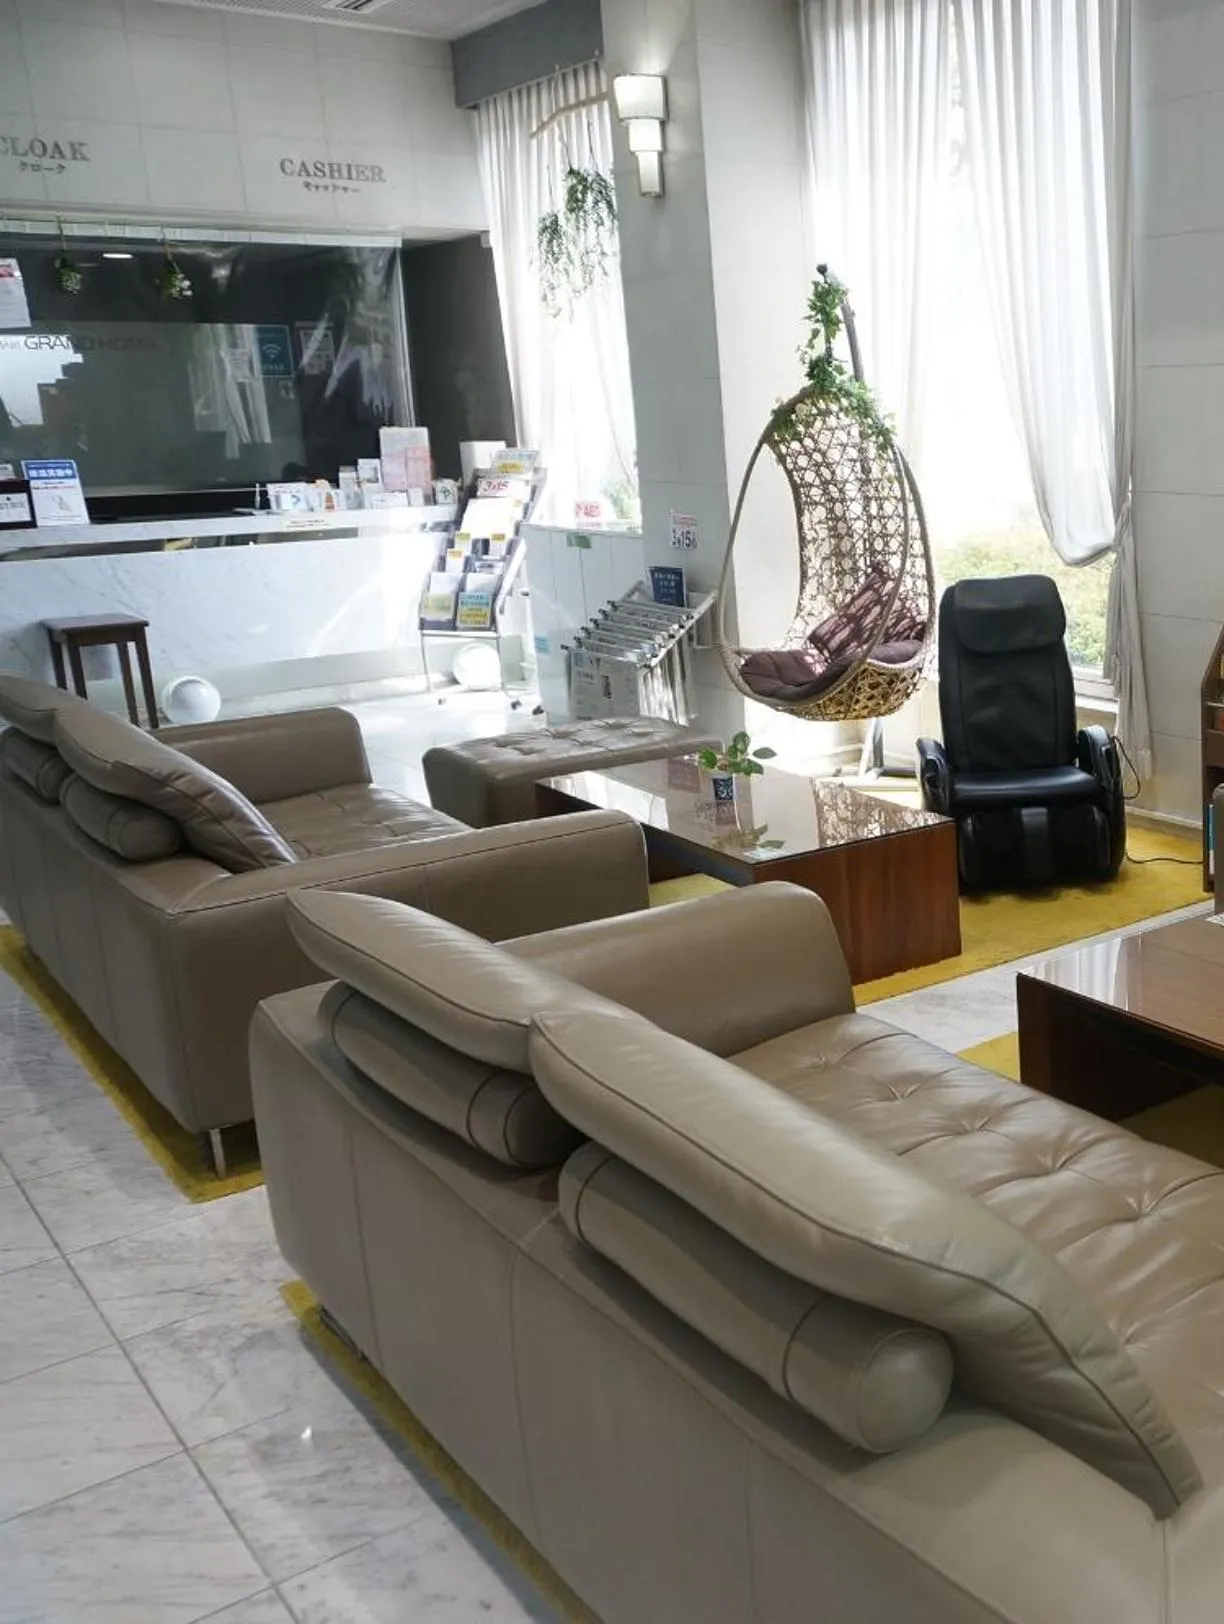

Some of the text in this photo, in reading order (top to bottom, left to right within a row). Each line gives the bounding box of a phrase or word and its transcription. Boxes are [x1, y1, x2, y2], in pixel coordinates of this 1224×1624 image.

[19, 160, 67, 175] クローク
[279, 158, 387, 183] CASHIER
